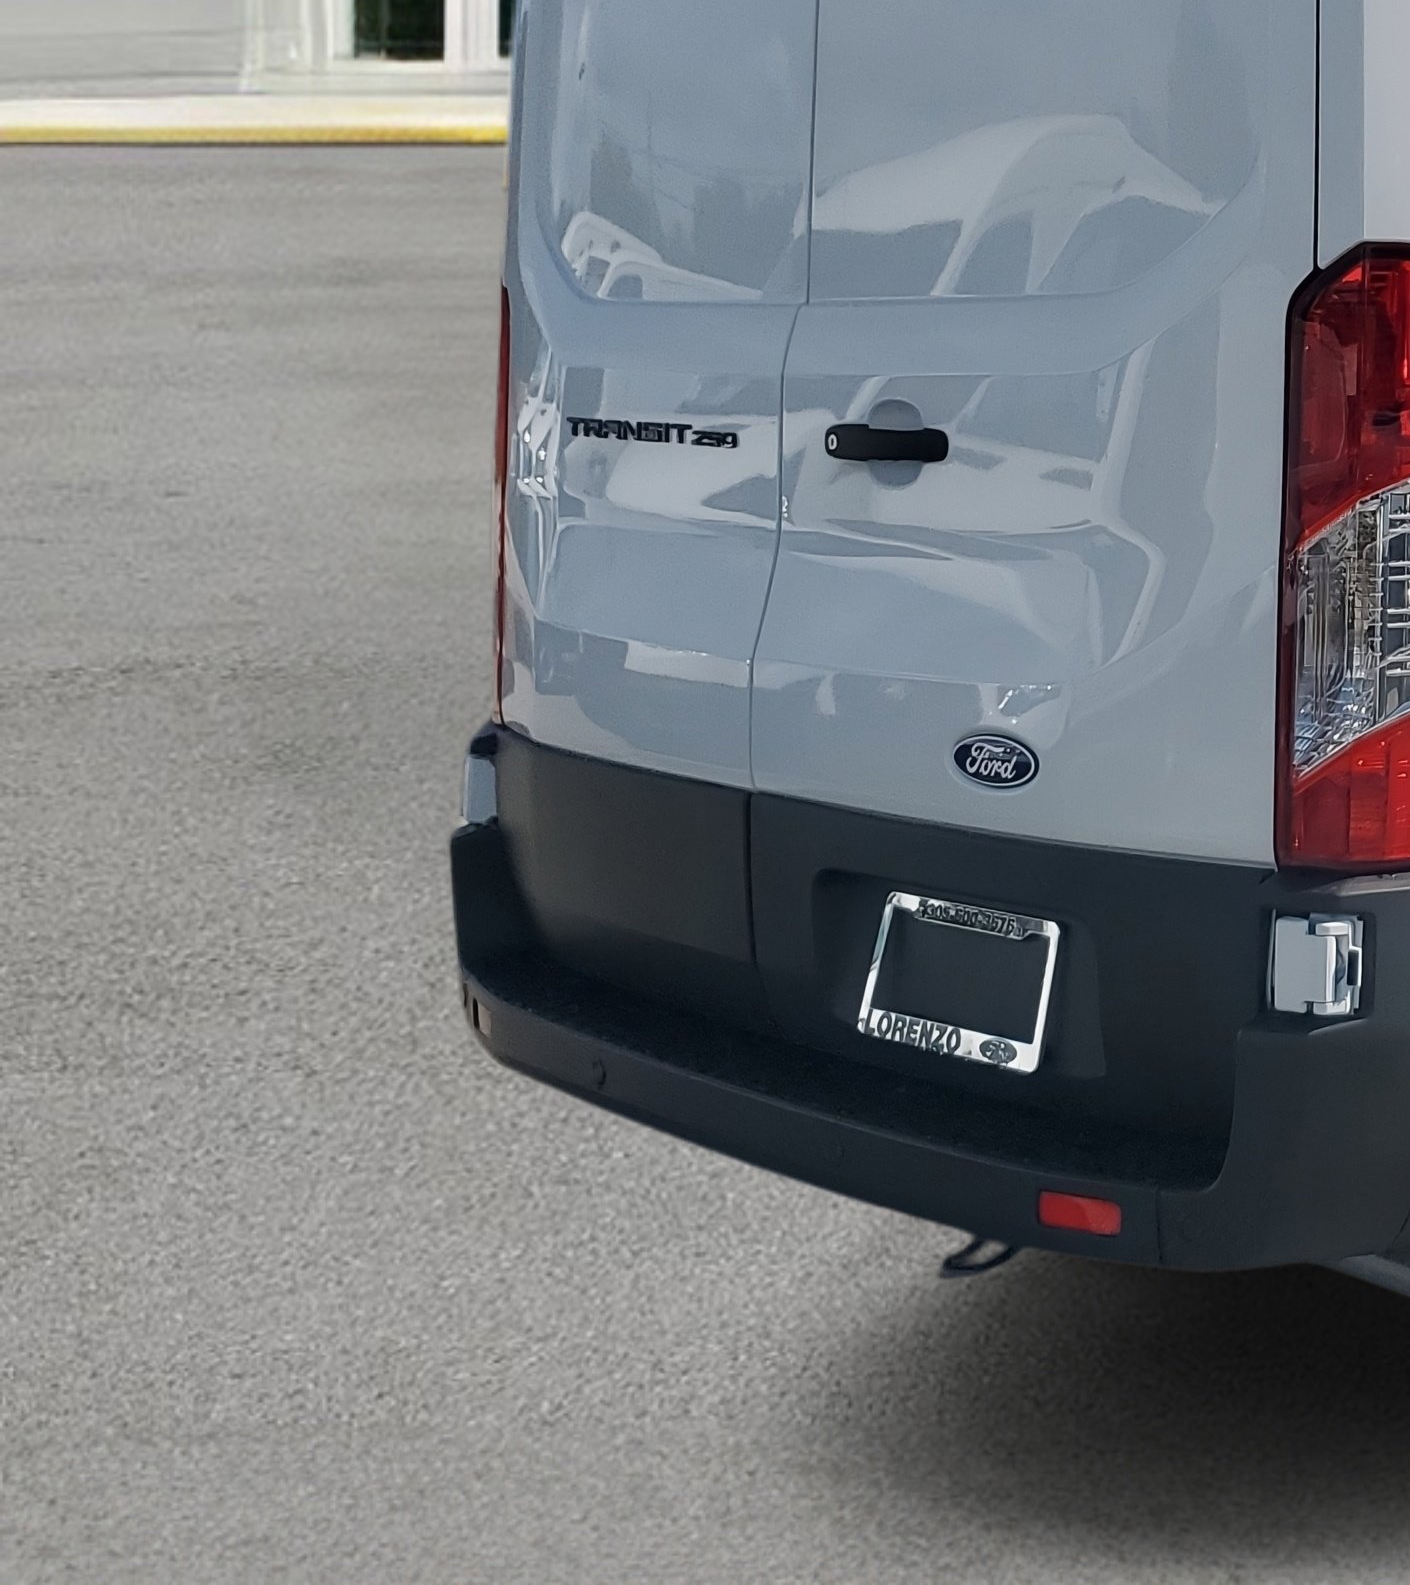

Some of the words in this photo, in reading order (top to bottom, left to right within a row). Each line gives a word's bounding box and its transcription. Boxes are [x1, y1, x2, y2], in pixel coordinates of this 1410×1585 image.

[566, 416, 693, 444] TRANSIT
[965, 741, 1017, 779] Ford
[864, 1007, 962, 1054] LORENZO
